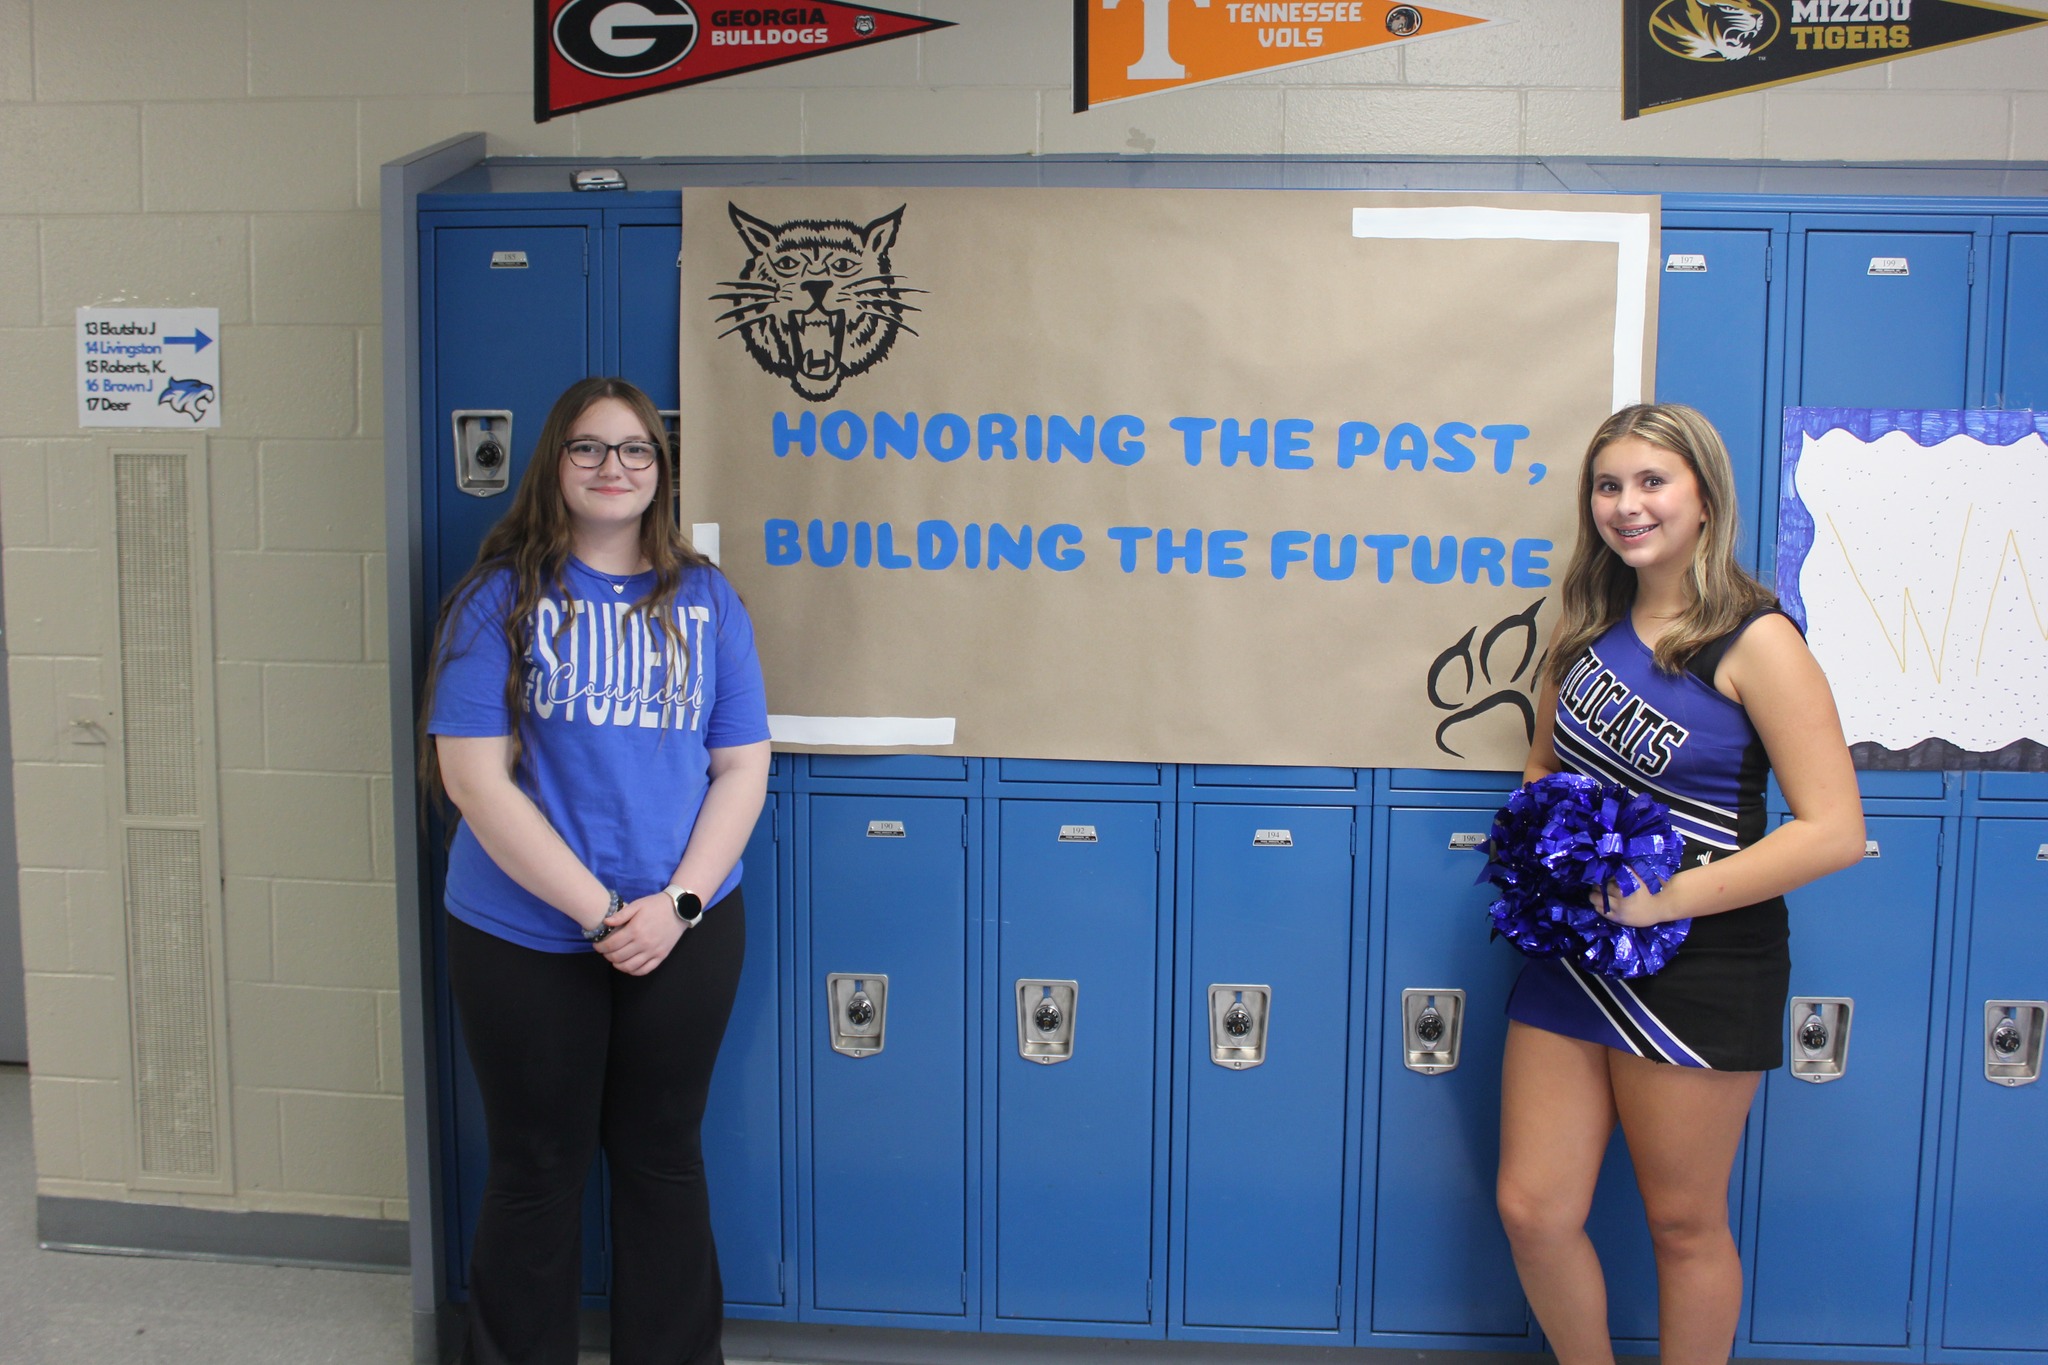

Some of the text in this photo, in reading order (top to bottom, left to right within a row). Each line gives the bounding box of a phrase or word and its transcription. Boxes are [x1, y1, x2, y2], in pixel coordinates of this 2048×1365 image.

[711, 8, 826, 27] GEORGIA
[1225, 2, 1363, 23] TENNESSEE
[1791, 0, 1911, 23] MIZZOU
[711, 28, 829, 46] BULLDOGS
[1258, 28, 1323, 48] VOLS
[1790, 25, 1910, 50] TIGERS
[1681, 256, 1693, 264] 197
[85, 321, 98, 335] 13
[149, 321, 156, 335] J
[85, 341, 162, 358] 14 Livingston
[85, 360, 166, 374] 15 Roberts, K.
[85, 379, 153, 392] 16 Brown J
[86, 398, 131, 411] 17 Deer
[772, 410, 1547, 485] HONORING THE PAST,
[765, 518, 1553, 588] BUILDING THE FUTURE
[534, 597, 710, 732] STUDENT
[547, 662, 705, 710] Council
[1073, 827, 1085, 835] 192
